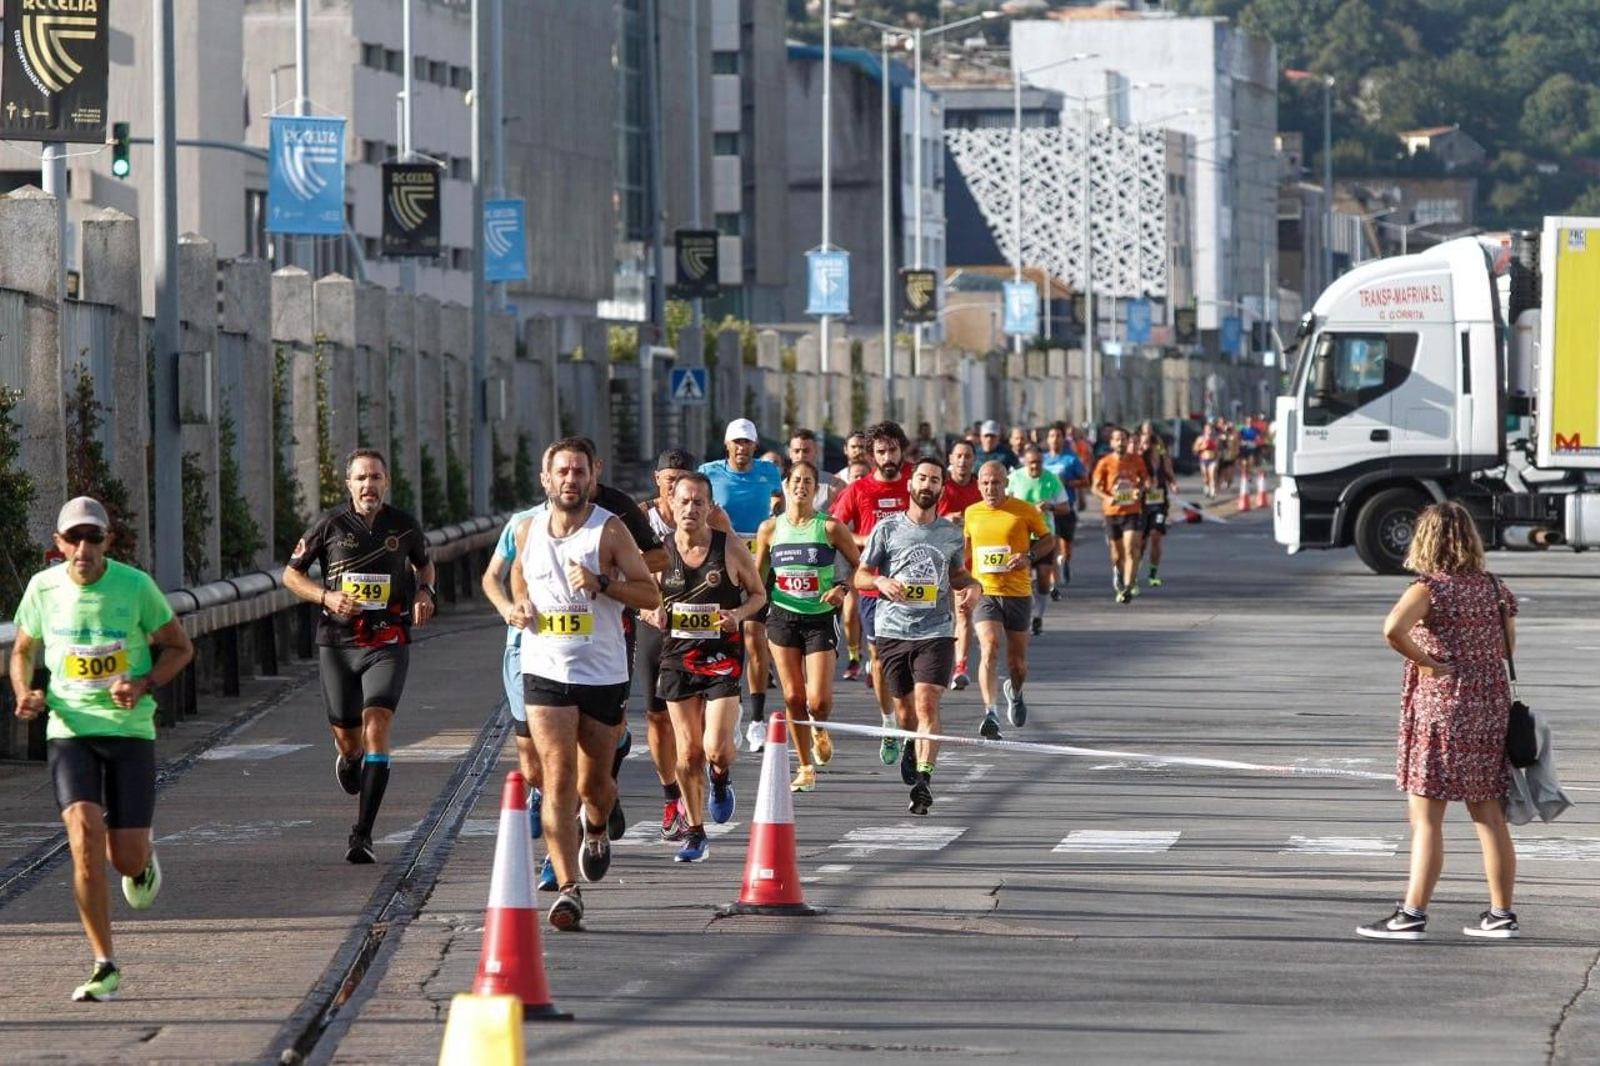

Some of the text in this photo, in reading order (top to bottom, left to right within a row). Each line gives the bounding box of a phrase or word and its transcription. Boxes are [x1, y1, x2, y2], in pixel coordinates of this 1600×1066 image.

[983, 554, 1004, 565] 267
[785, 578, 811, 591] 405
[351, 583, 382, 601] 249
[906, 586, 924, 599] 29
[547, 615, 580, 632] 115
[680, 614, 711, 628] 208
[77, 655, 117, 676] 300
